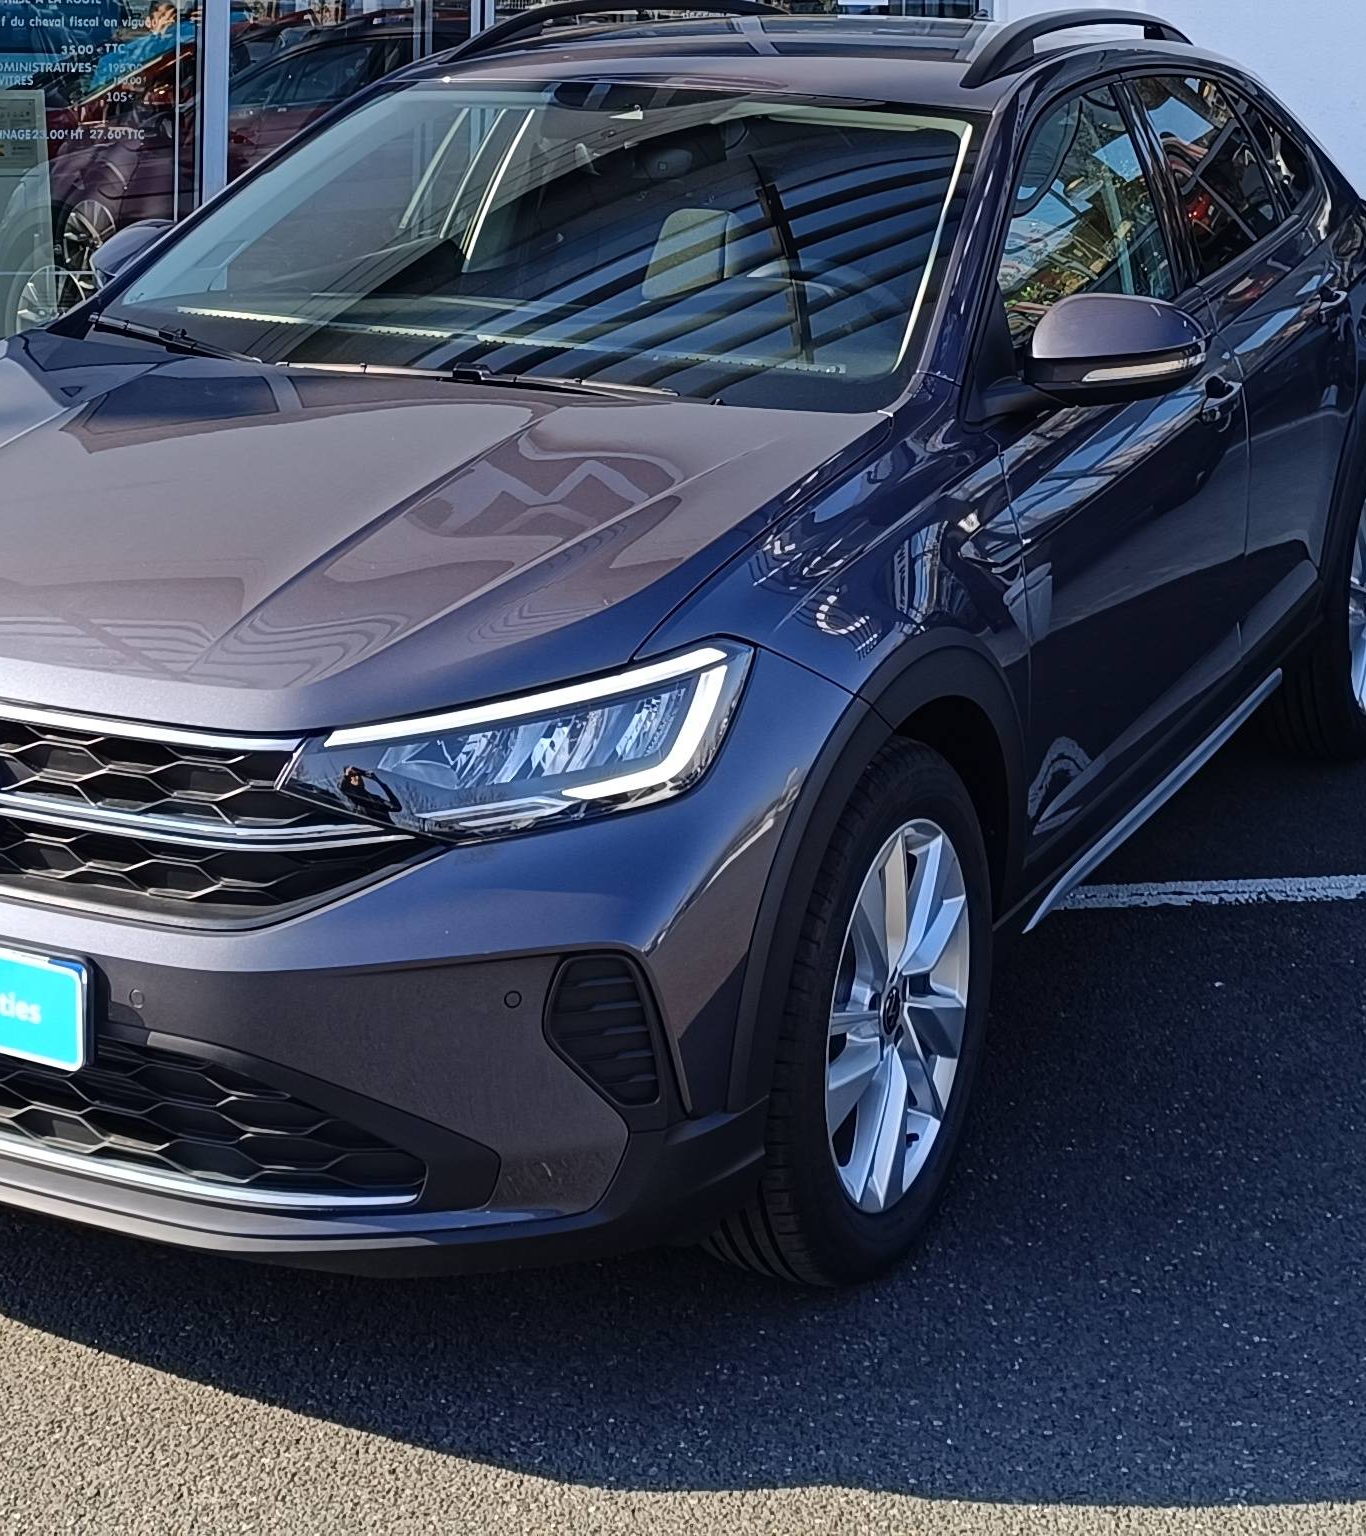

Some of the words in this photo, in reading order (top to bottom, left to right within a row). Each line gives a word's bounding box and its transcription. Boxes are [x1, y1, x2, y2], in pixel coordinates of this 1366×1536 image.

[11, 16, 25, 27] du
[29, 16, 65, 27] cheval
[69, 16, 99, 27] fiscal
[104, 18, 118, 27] en
[104, 43, 126, 54] TTC
